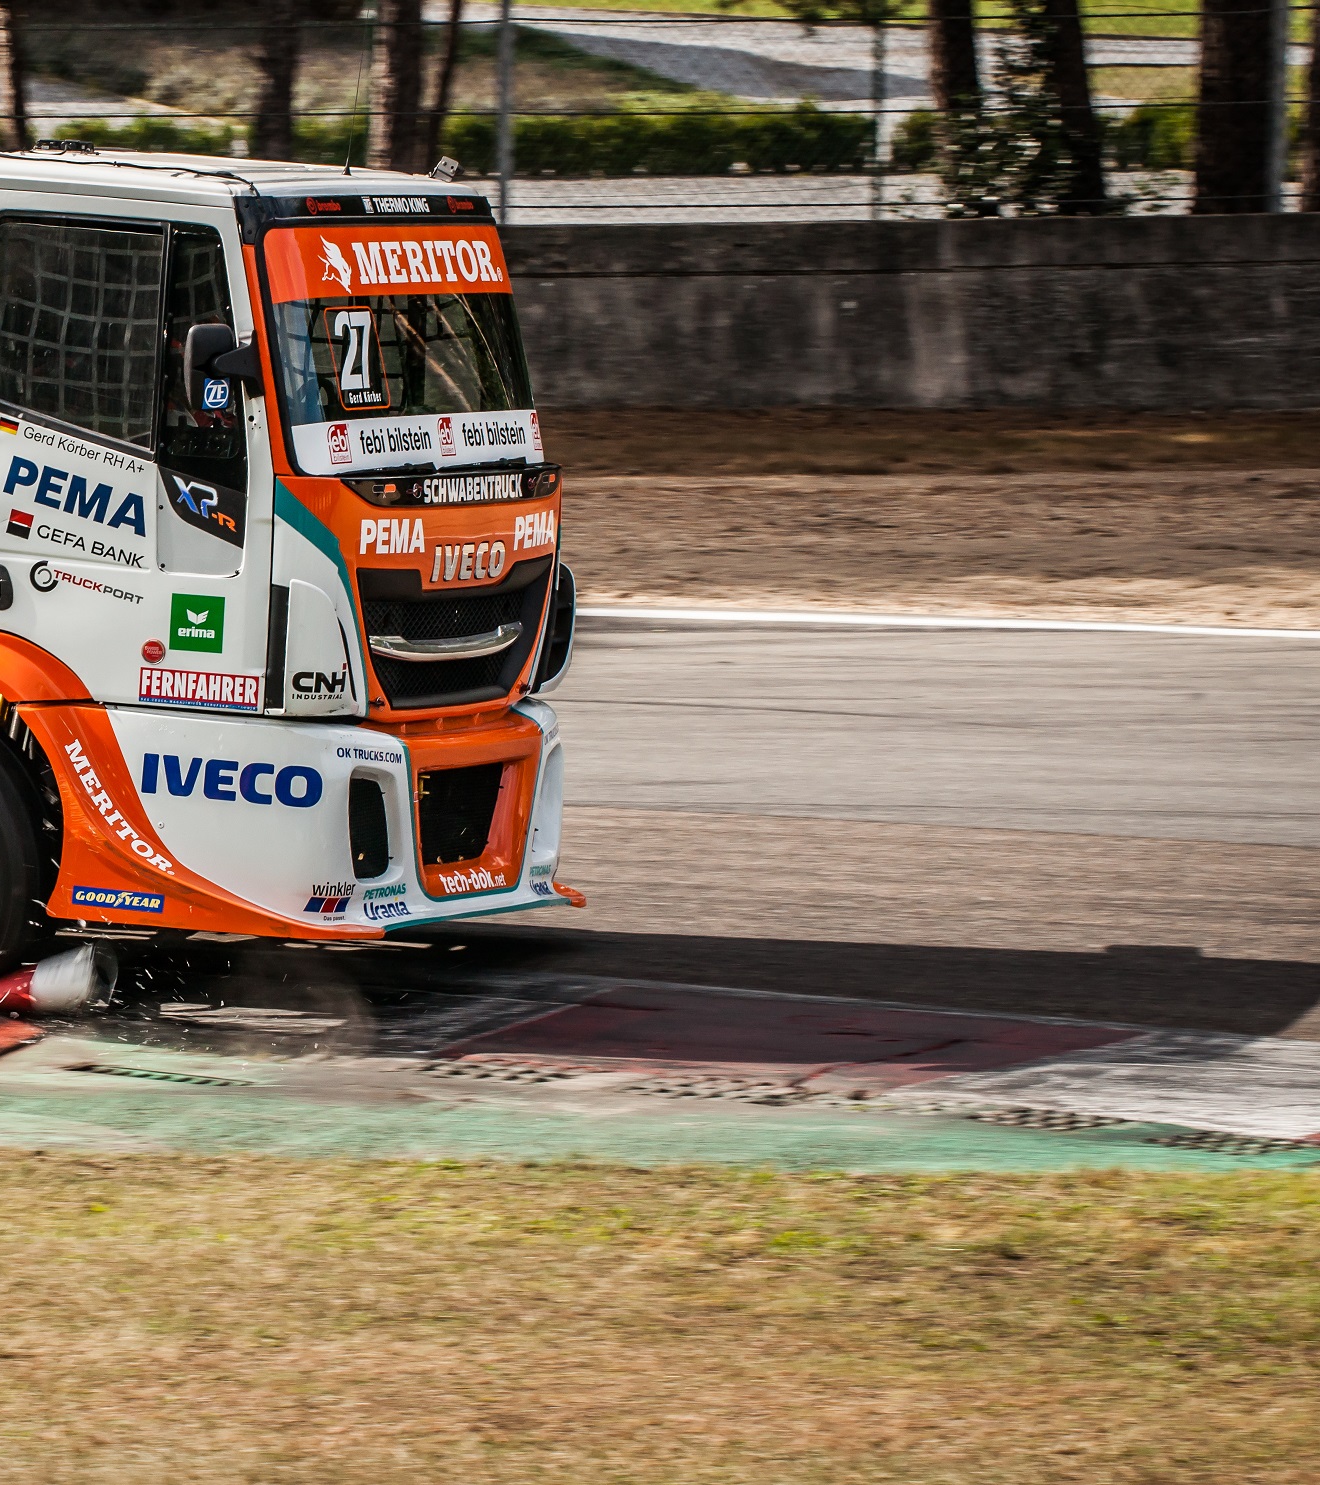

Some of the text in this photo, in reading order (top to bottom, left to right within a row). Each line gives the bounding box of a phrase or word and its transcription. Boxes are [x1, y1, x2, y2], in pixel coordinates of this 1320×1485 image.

[317, 199, 341, 211] brembo
[373, 197, 430, 213] THERMO KING
[351, 240, 498, 285] MERITOR
[334, 310, 372, 390] 27
[349, 391, 363, 404] Gerd
[328, 425, 349, 452] febi
[360, 426, 431, 454] febi bilstein
[438, 418, 454, 445] febi
[462, 422, 482, 447] febi
[486, 421, 526, 446] bilstein
[23, 426, 145, 473] Gerd Körber RH A+
[3, 456, 146, 537] PEMA
[423, 474, 523, 503] SCHWABENTRUCK
[359, 518, 426, 555] PEMA
[513, 509, 556, 551] PEMA
[37, 524, 145, 569] GEFA BANK
[430, 540, 506, 583] IVECO
[53, 569, 144, 604] TRUCKPORT
[177, 626, 216, 639] erima
[141, 669, 257, 704] FERNFAHRER
[336, 747, 402, 764] OK TRUCKS.COM
[141, 753, 323, 807] IVECO
[312, 881, 356, 896] winkler
[363, 883, 407, 900] PETRONAS
[439, 867, 506, 894] tech-dok.net
[75, 890, 162, 908] GOODYEAR
[363, 897, 412, 920] Urania
